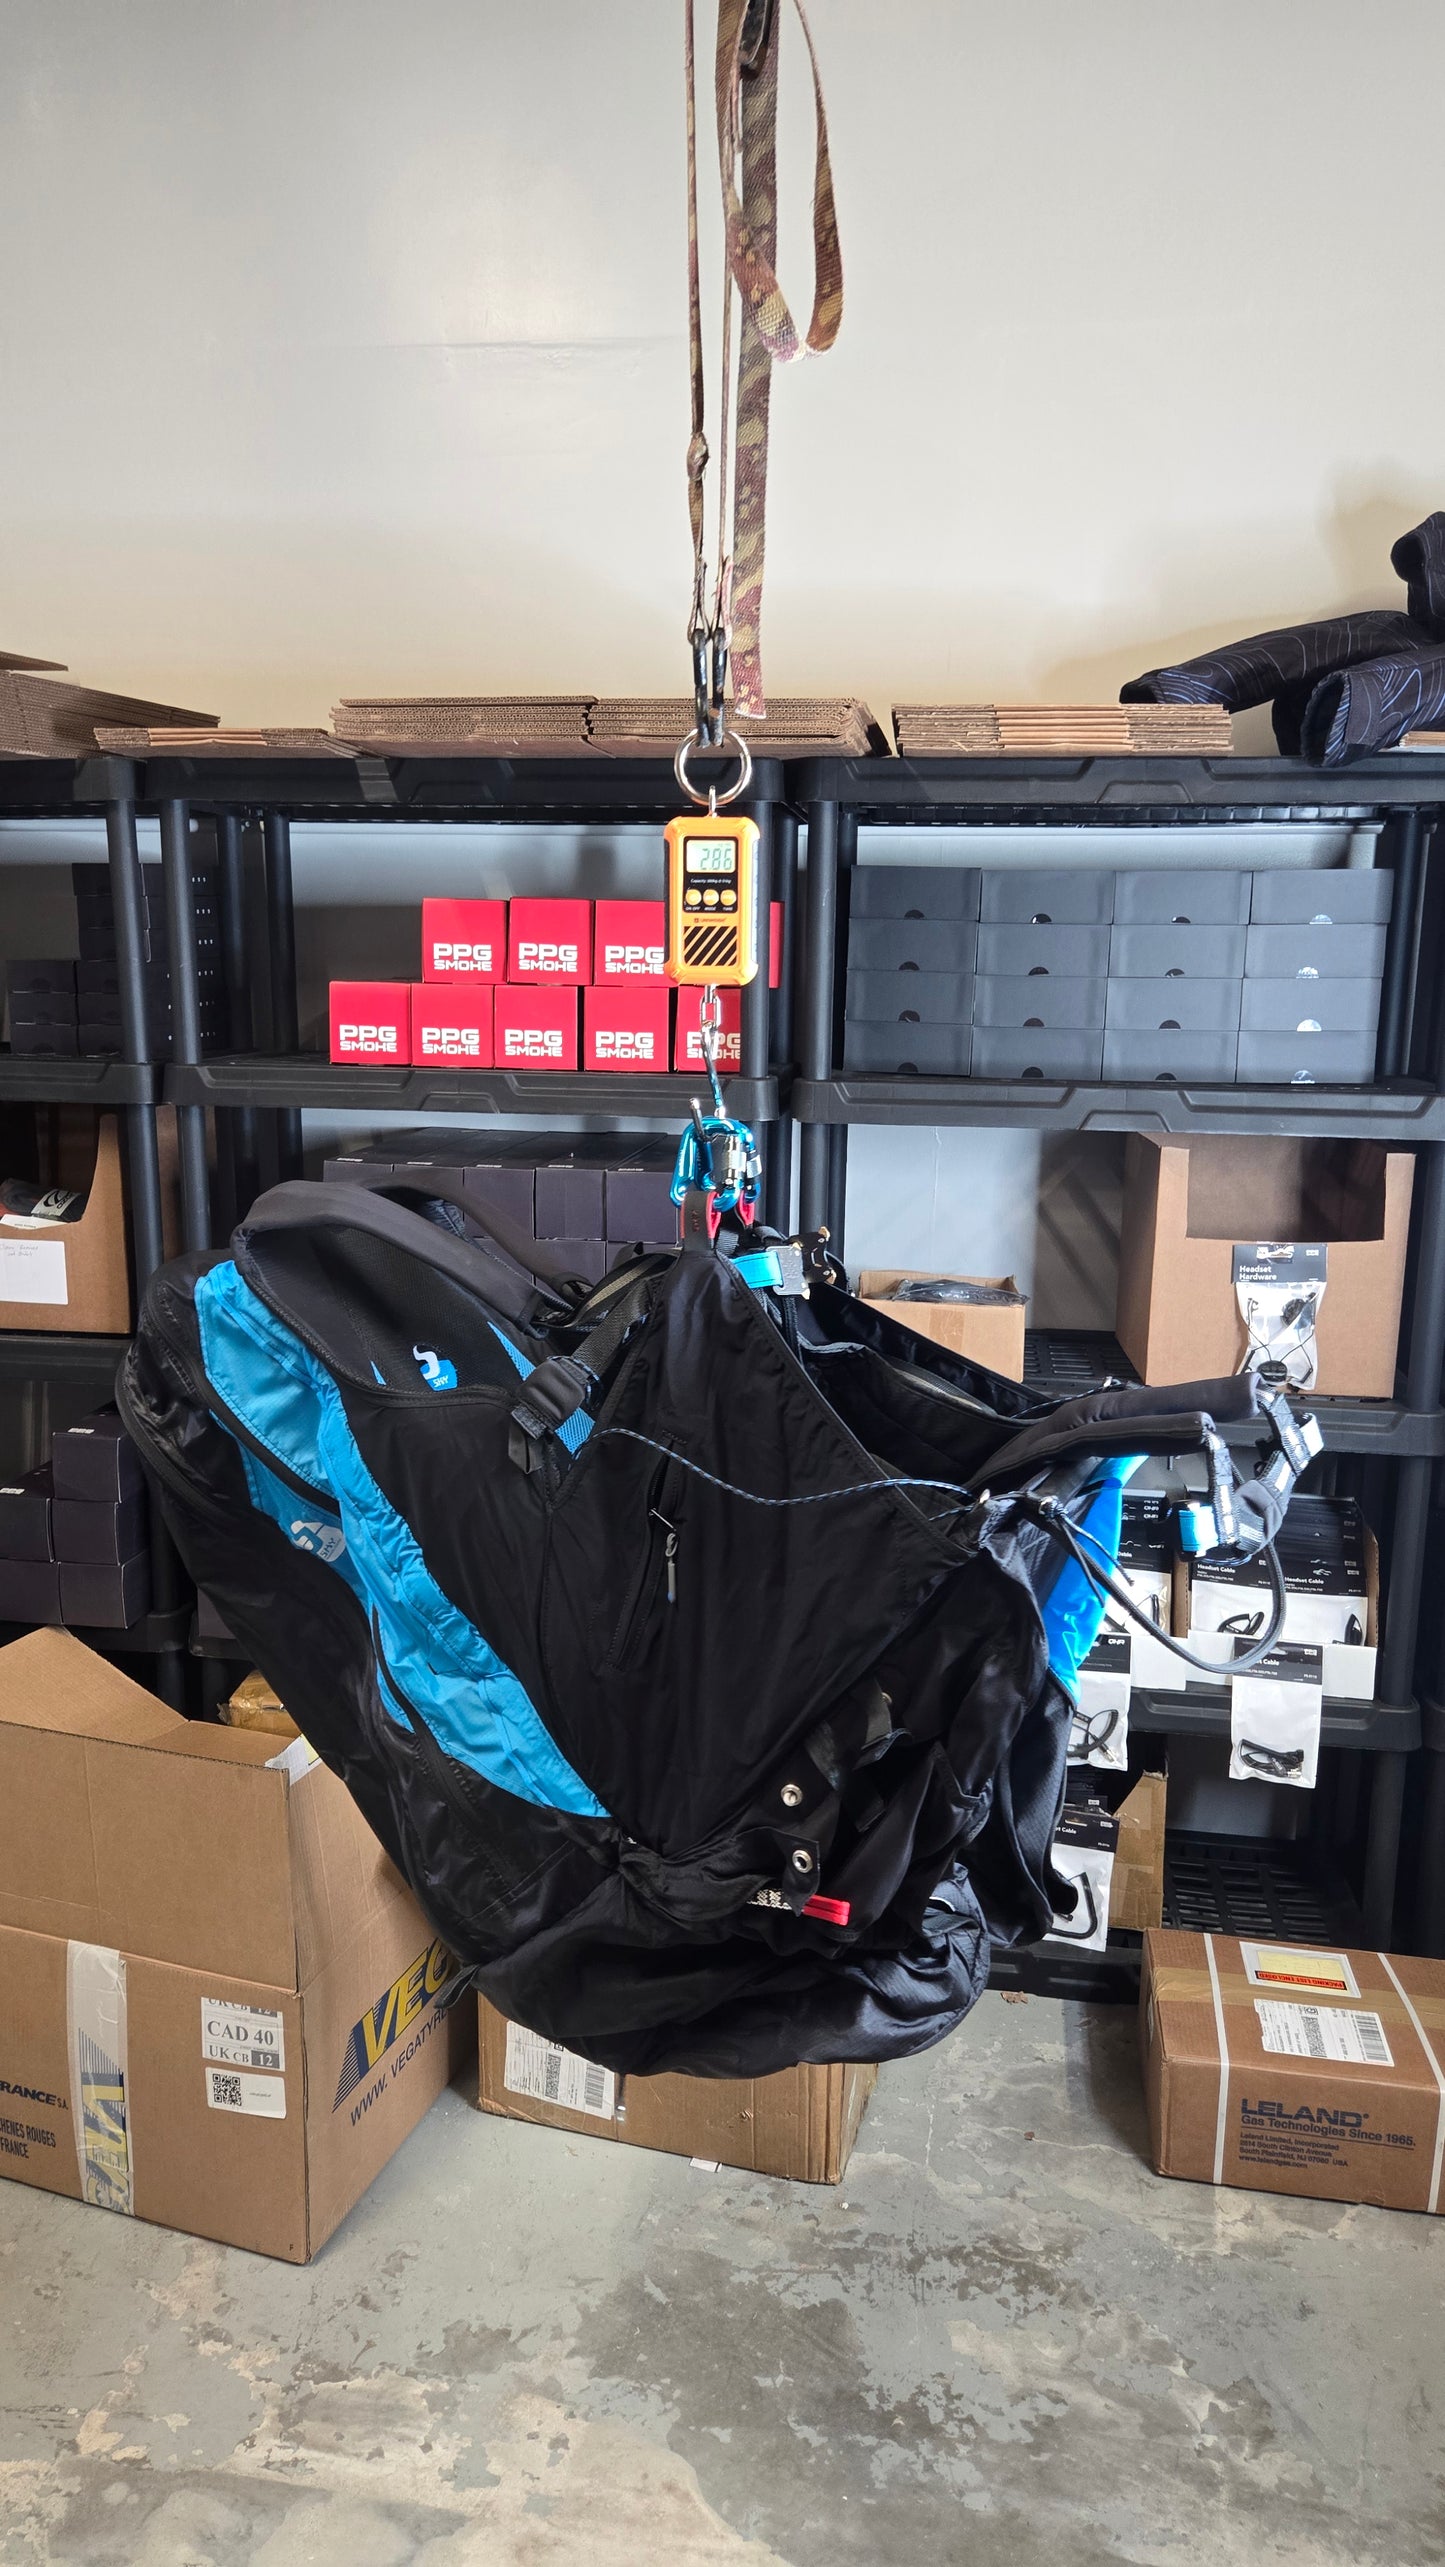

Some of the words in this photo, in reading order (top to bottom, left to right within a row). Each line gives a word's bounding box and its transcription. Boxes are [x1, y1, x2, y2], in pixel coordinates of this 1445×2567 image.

[433, 943, 492, 961] PPG
[518, 943, 578, 962] PPG
[605, 945, 664, 964] PPG
[339, 1024, 397, 1042] PPG
[421, 1027, 480, 1044] PPG
[504, 1029, 563, 1047] PPG
[595, 1031, 654, 1049] PPG
[1239, 1265, 1272, 1273] Headset
[1197, 1563, 1220, 1572] Headset
[1220, 1566, 1236, 1574] Cable
[1284, 1576, 1308, 1584] Headset
[1061, 1827, 1077, 1835] Cable
[207, 2020, 249, 2042] CAD
[253, 2029, 274, 2046] 40
[209, 2045, 230, 2059] UK
[233, 2052, 249, 2063] CB
[259, 2054, 274, 2067] 12
[0, 2081, 57, 2106] RANCE
[350, 2073, 388, 2126] WWW.
[0, 2118, 25, 2139] HENES
[26, 2125, 57, 2148] ROUGES
[1241, 2114, 1265, 2126] Gas
[1269, 2117, 1346, 2137] Technologies
[1349, 2128, 1382, 2141] Since
[1386, 2133, 1416, 2147] 1965.
[0, 2136, 29, 2159] FRANCE
[1240, 2132, 1264, 2140] Leland
[1294, 2139, 1339, 2151] Incorporated
[1257, 2141, 1278, 2150] South
[1306, 2148, 1332, 2157] Avenue
[1239, 2147, 1260, 2155] South
[1332, 2159, 1349, 2167] USA
